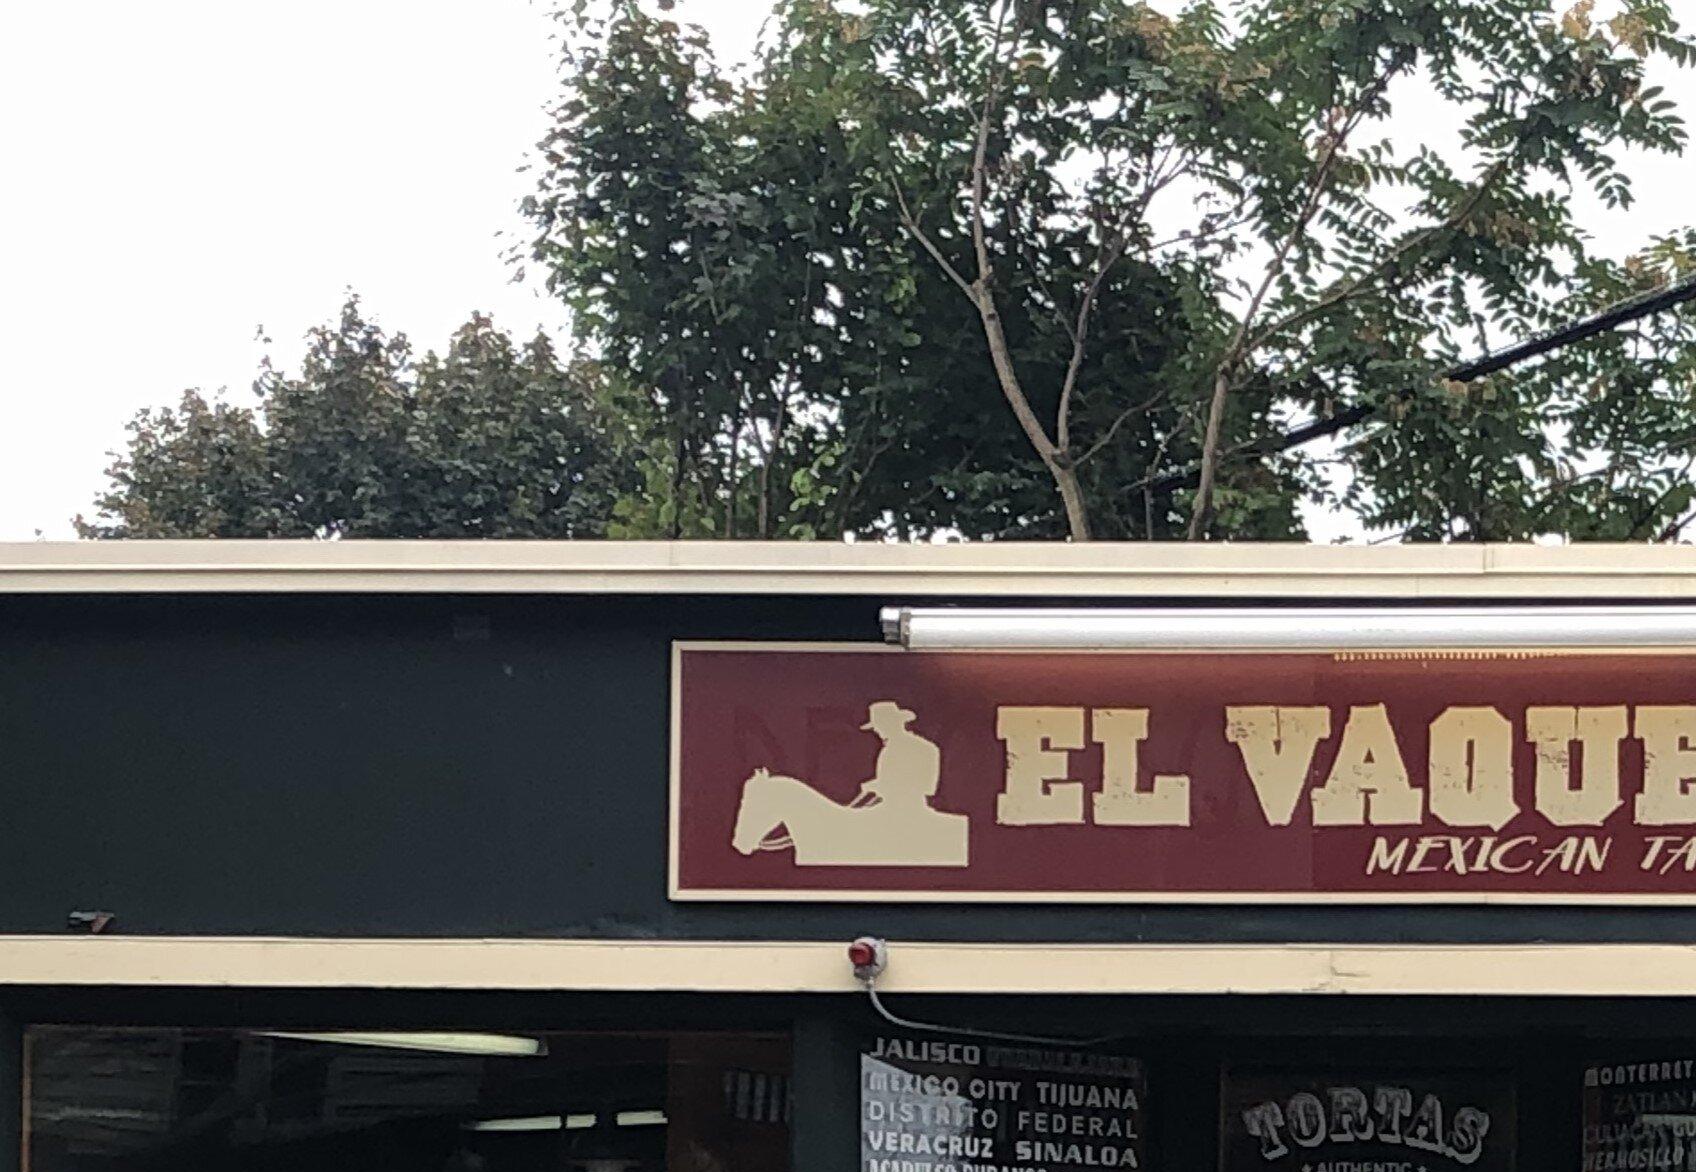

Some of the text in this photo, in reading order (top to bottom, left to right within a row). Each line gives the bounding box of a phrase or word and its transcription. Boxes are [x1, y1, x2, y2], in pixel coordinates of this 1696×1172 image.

[996, 706, 1190, 828] EL
[1366, 835, 1611, 877] MEXICAN
[870, 1037, 980, 1065] JALISCO
[869, 1071, 1139, 1110] MEXICO CITY TIJUANA
[1584, 1060, 1694, 1087] MONTERREY
[869, 1101, 1138, 1139] DISTRITO FEDERAL
[1241, 1086, 1490, 1164] TORTAS
[867, 1130, 1138, 1168] VERACRUZ SINALOA
